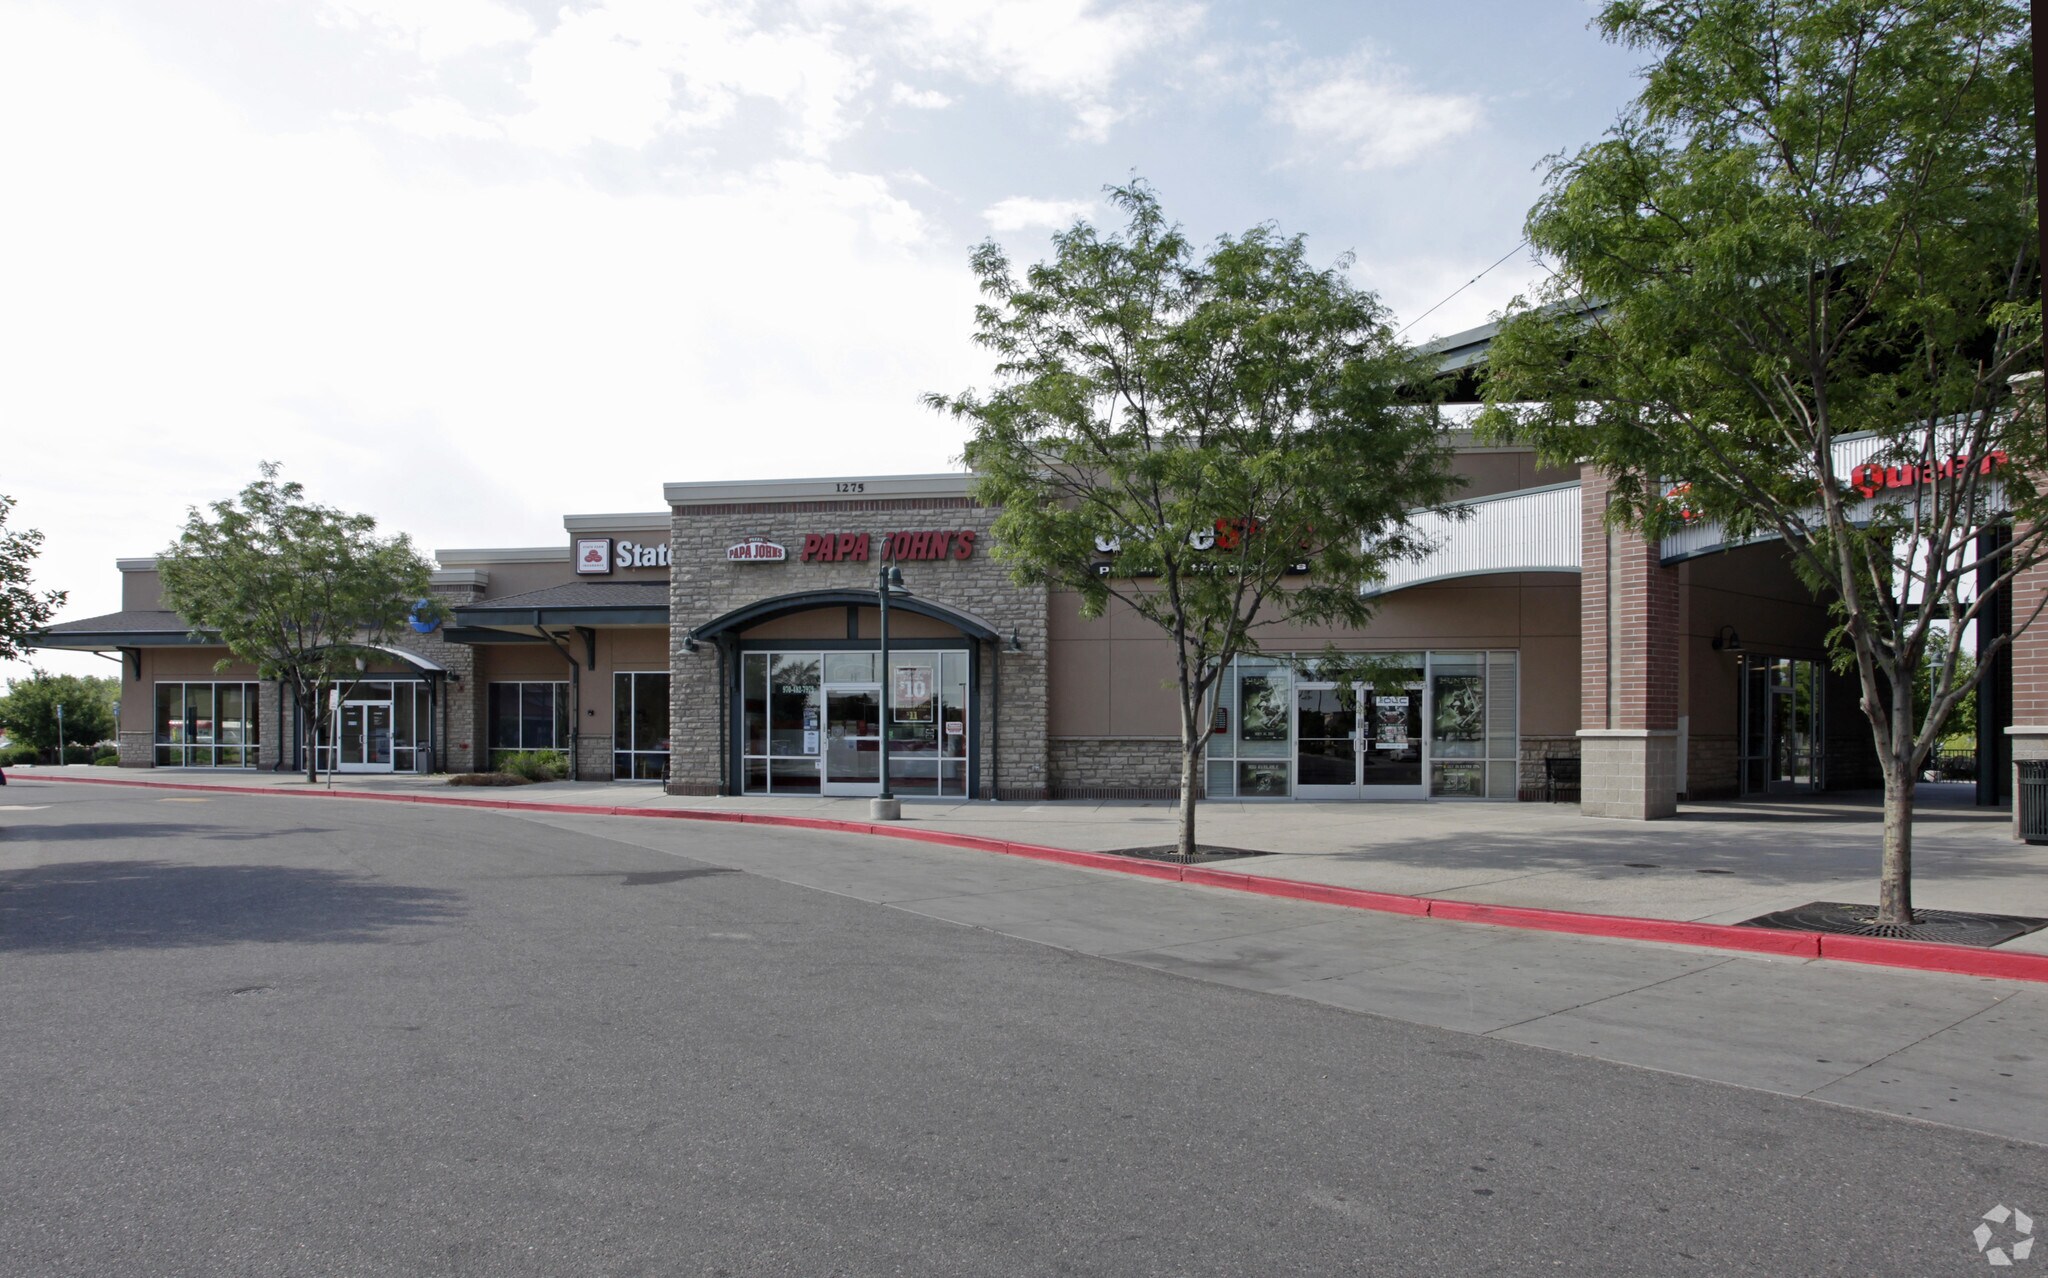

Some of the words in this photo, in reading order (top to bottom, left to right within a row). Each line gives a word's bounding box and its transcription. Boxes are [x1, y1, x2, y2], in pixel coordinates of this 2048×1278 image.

[836, 483, 864, 493] 1275
[729, 545, 751, 559] PAPA
[800, 533, 870, 562] PAPA
[881, 530, 975, 561] JOHN'S
[1439, 677, 1479, 685] HUNTED
[899, 681, 925, 698] $10
